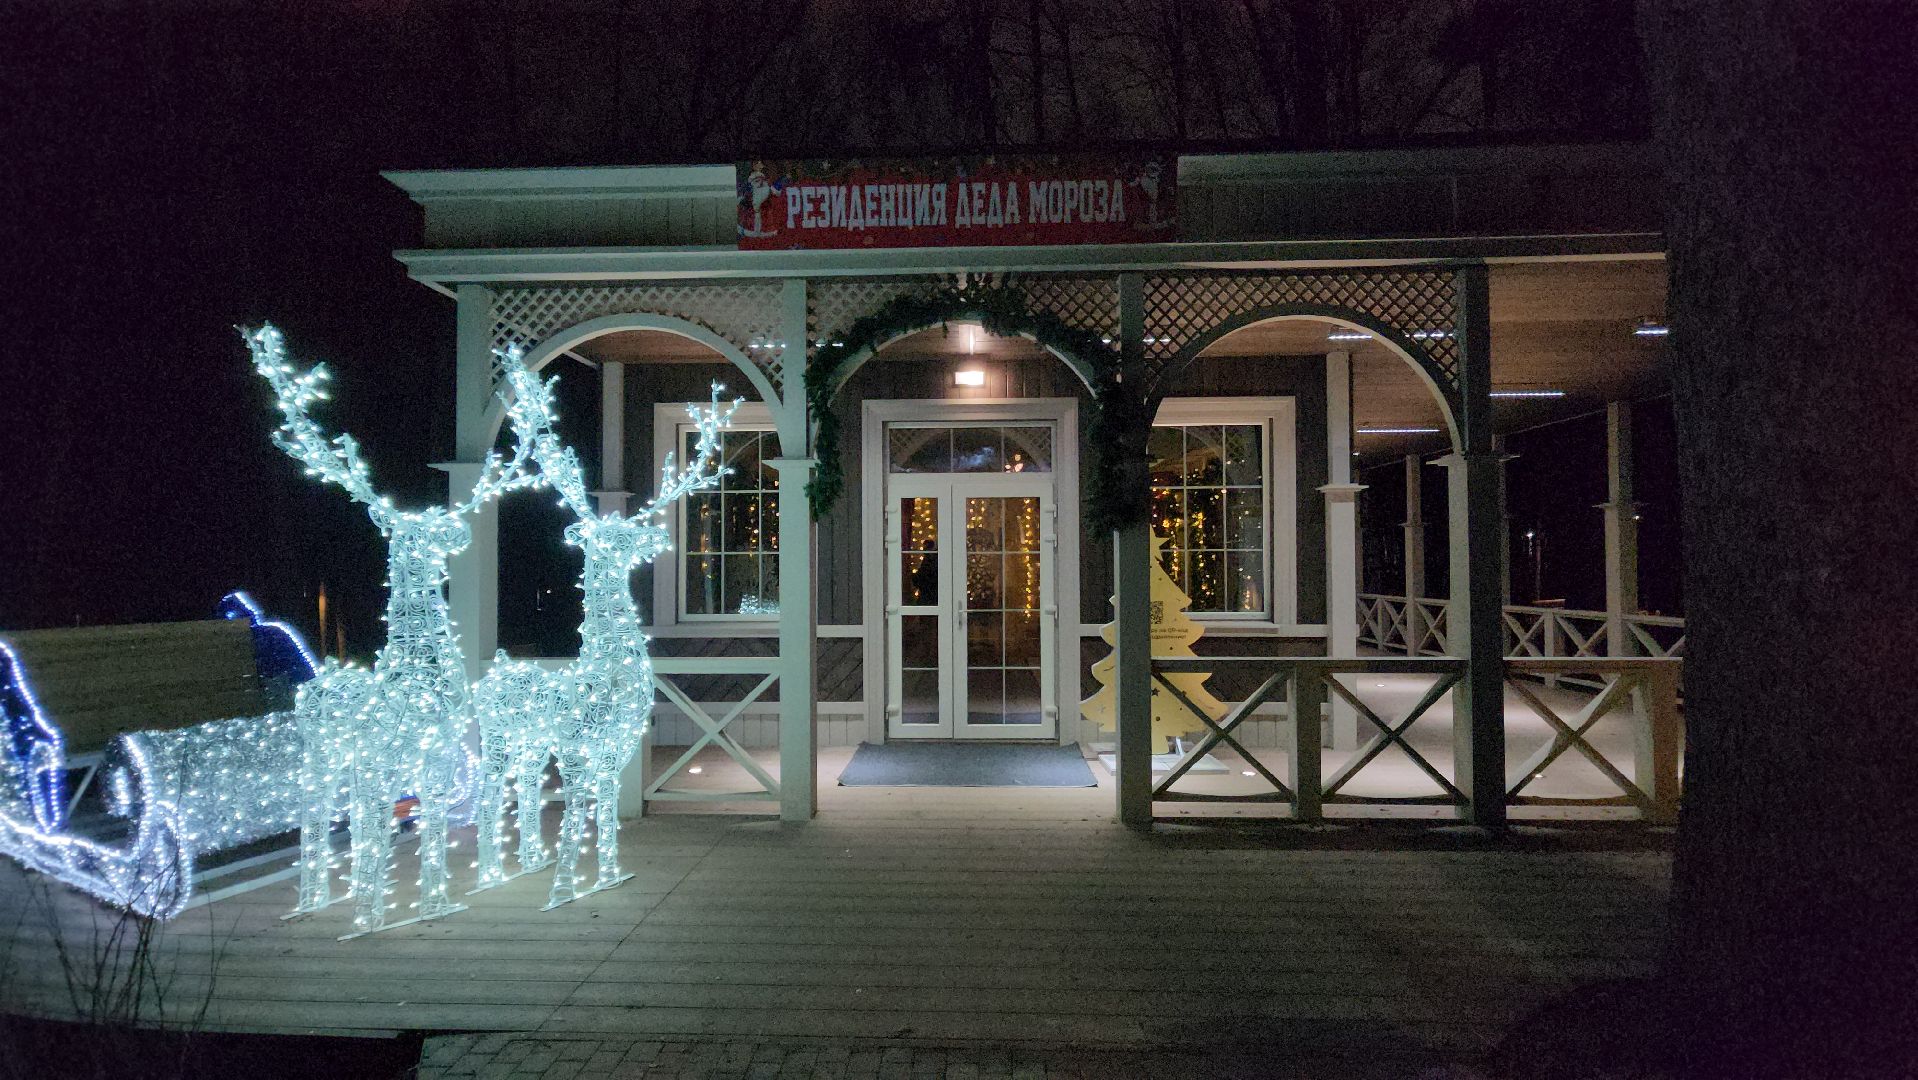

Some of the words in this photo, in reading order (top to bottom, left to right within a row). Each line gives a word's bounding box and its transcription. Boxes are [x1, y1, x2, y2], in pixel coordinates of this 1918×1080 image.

[786, 183, 947, 231] РЕЗИДЕНЦИЯ
[955, 181, 1020, 229] ДЕДА
[1028, 179, 1127, 224] МОРОЗА
